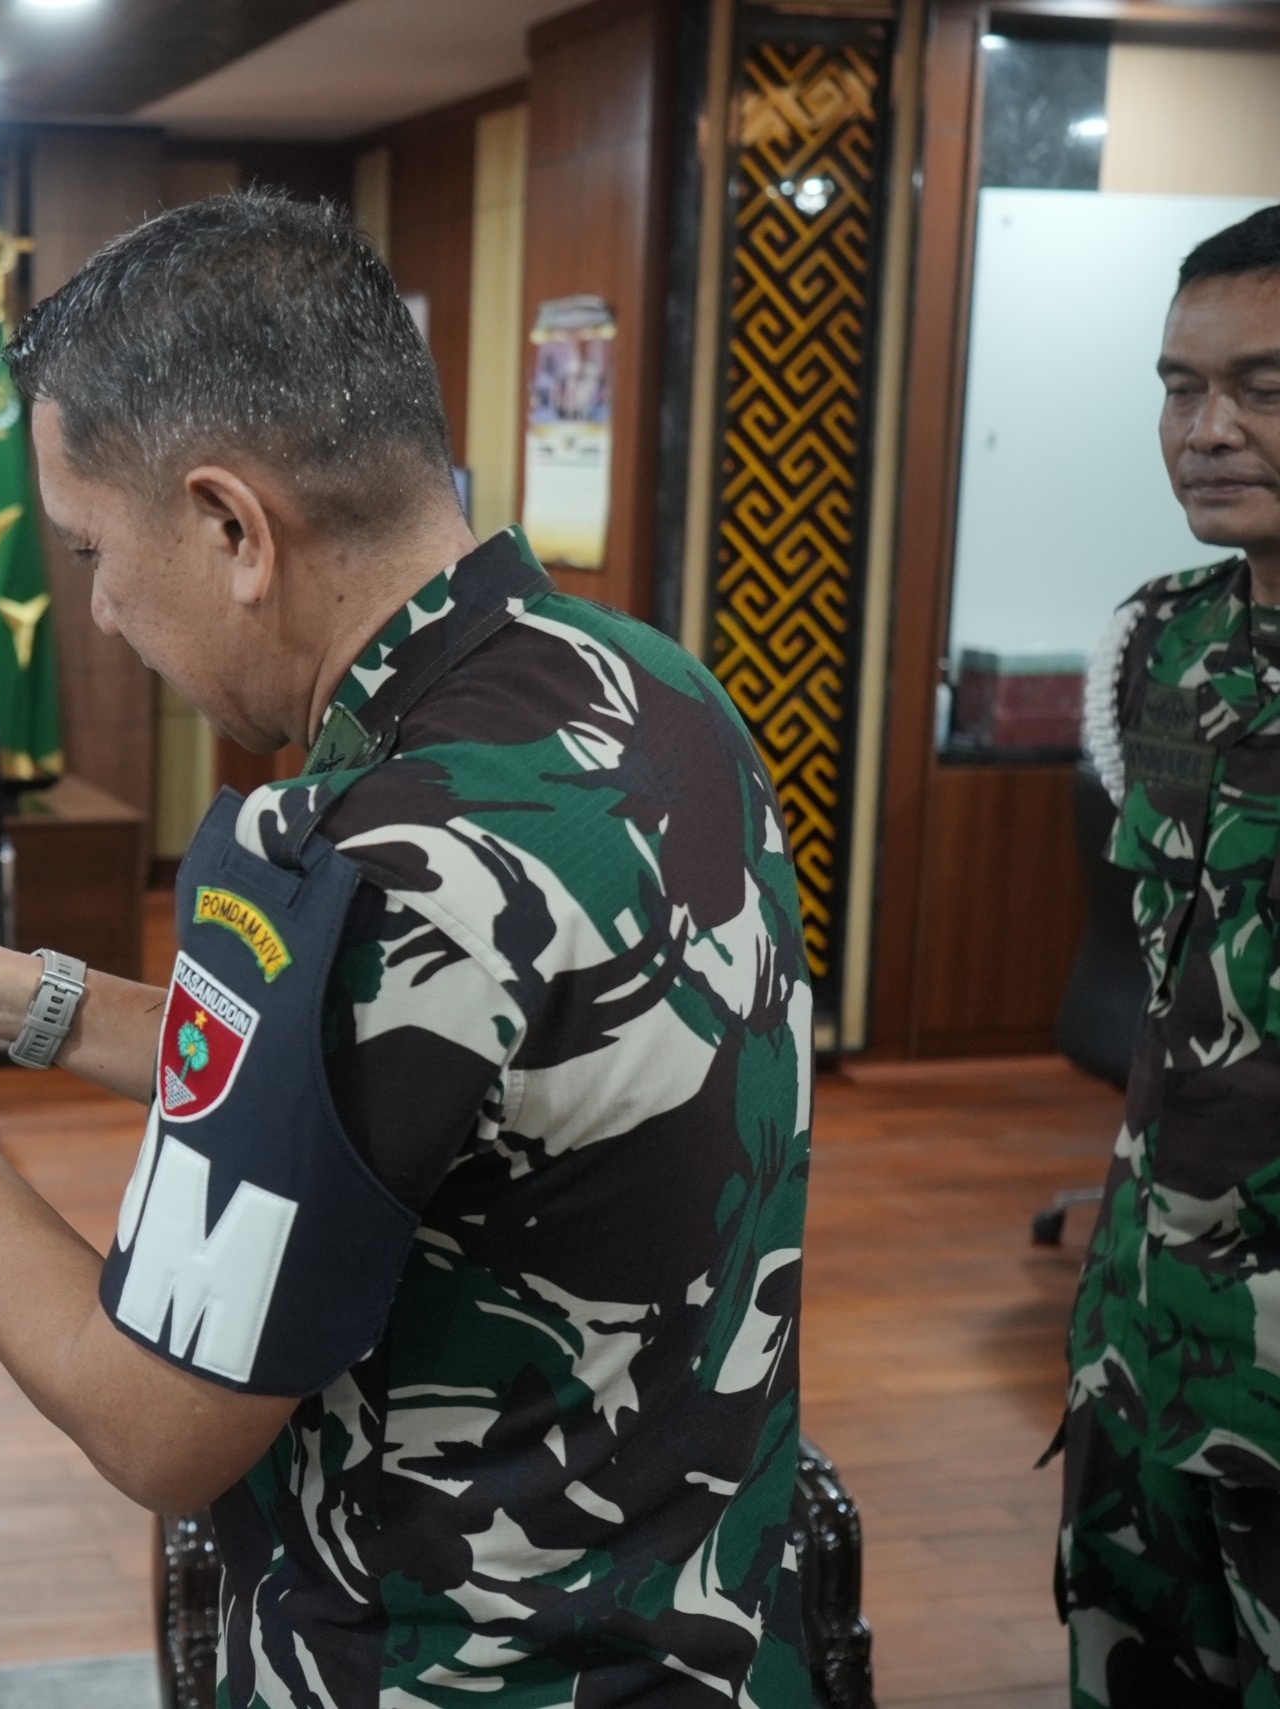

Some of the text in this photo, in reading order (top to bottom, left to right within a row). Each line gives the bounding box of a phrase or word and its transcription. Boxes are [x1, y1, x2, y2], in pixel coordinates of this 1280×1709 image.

[202, 894, 283, 965] POMDAM XIV
[175, 960, 253, 1035] HASANUDDIN
